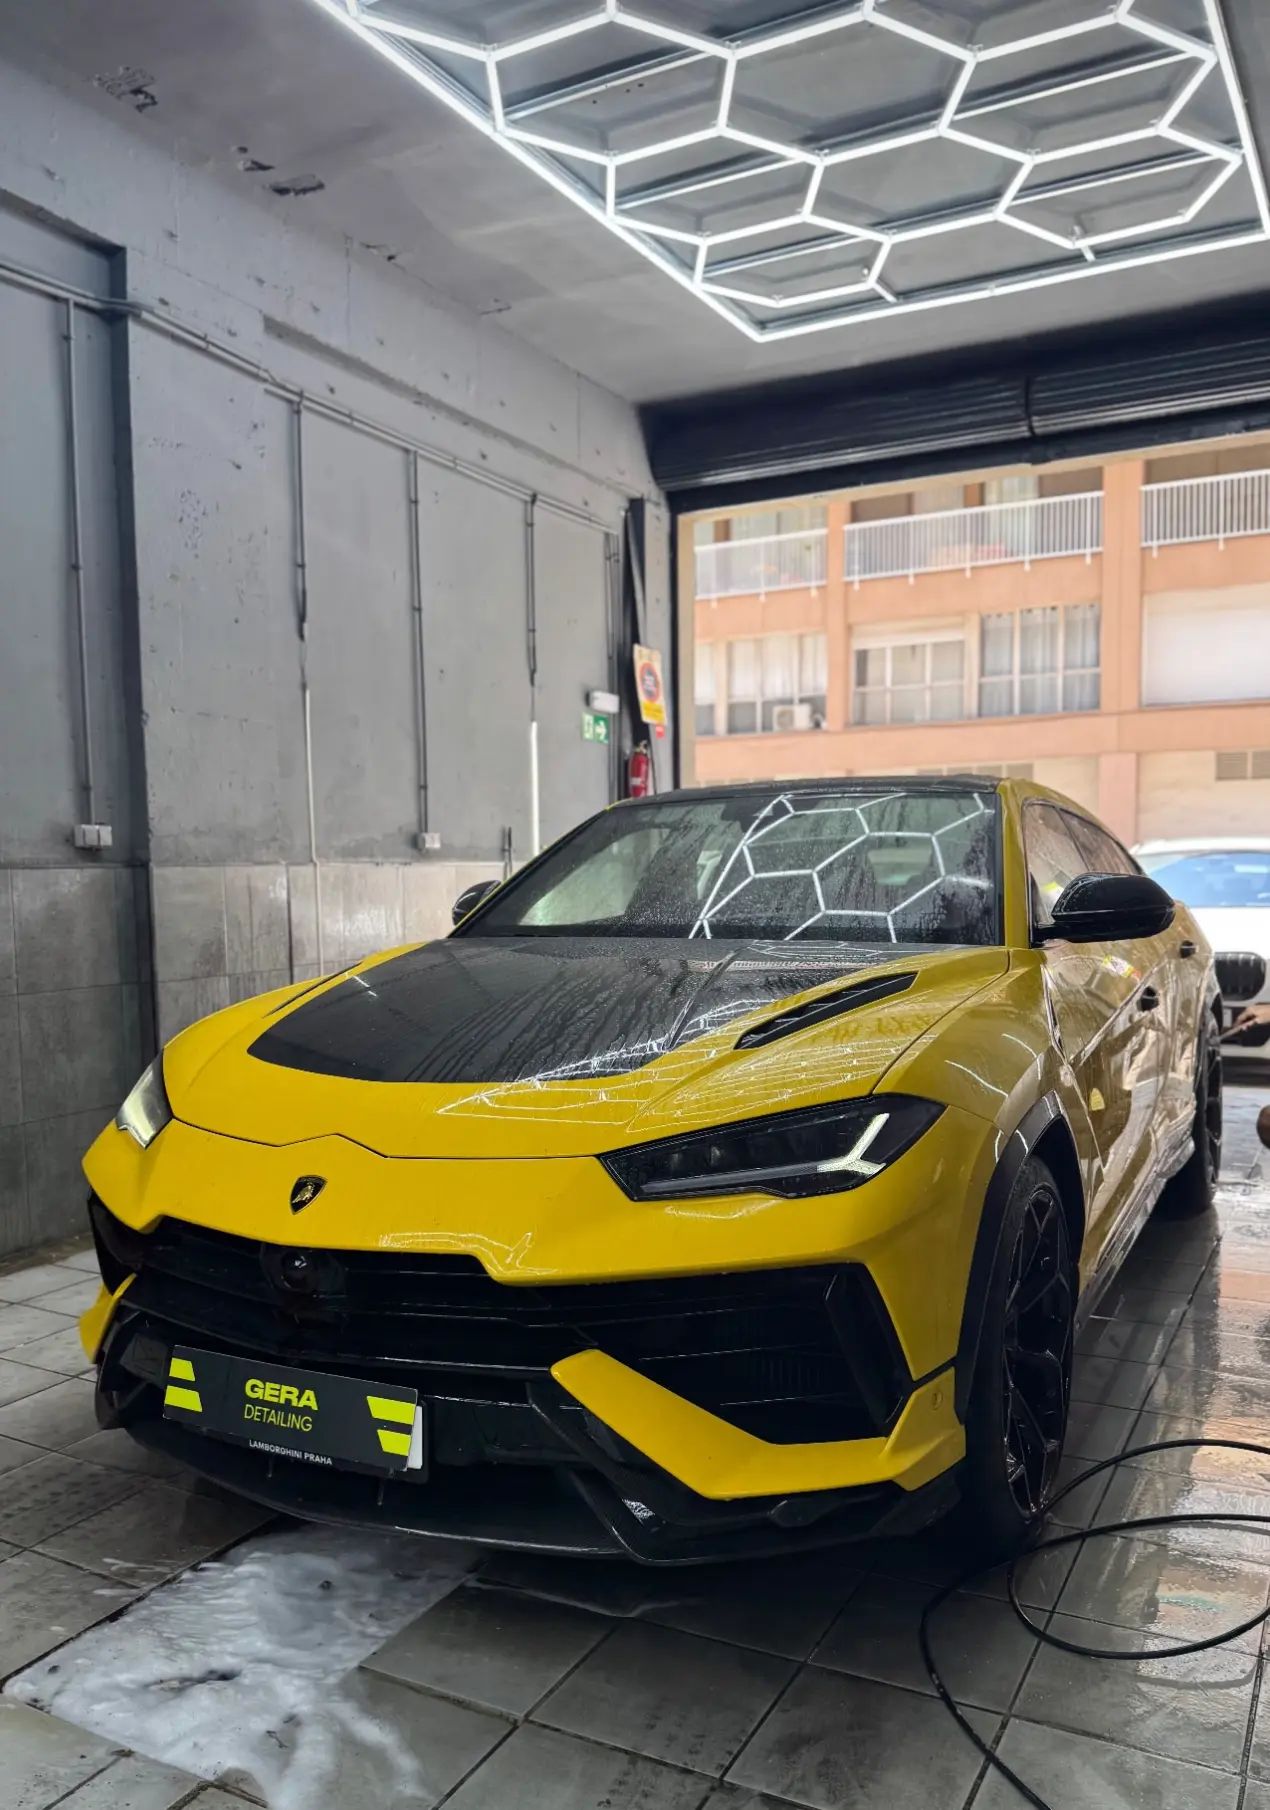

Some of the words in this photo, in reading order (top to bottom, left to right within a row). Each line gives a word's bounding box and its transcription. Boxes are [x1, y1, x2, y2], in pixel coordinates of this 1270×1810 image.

[244, 1378, 318, 1411] GERA
[244, 1403, 313, 1432] DETAILING
[249, 1439, 302, 1459] LAMBORGHINI
[304, 1453, 333, 1466] PRAHA
